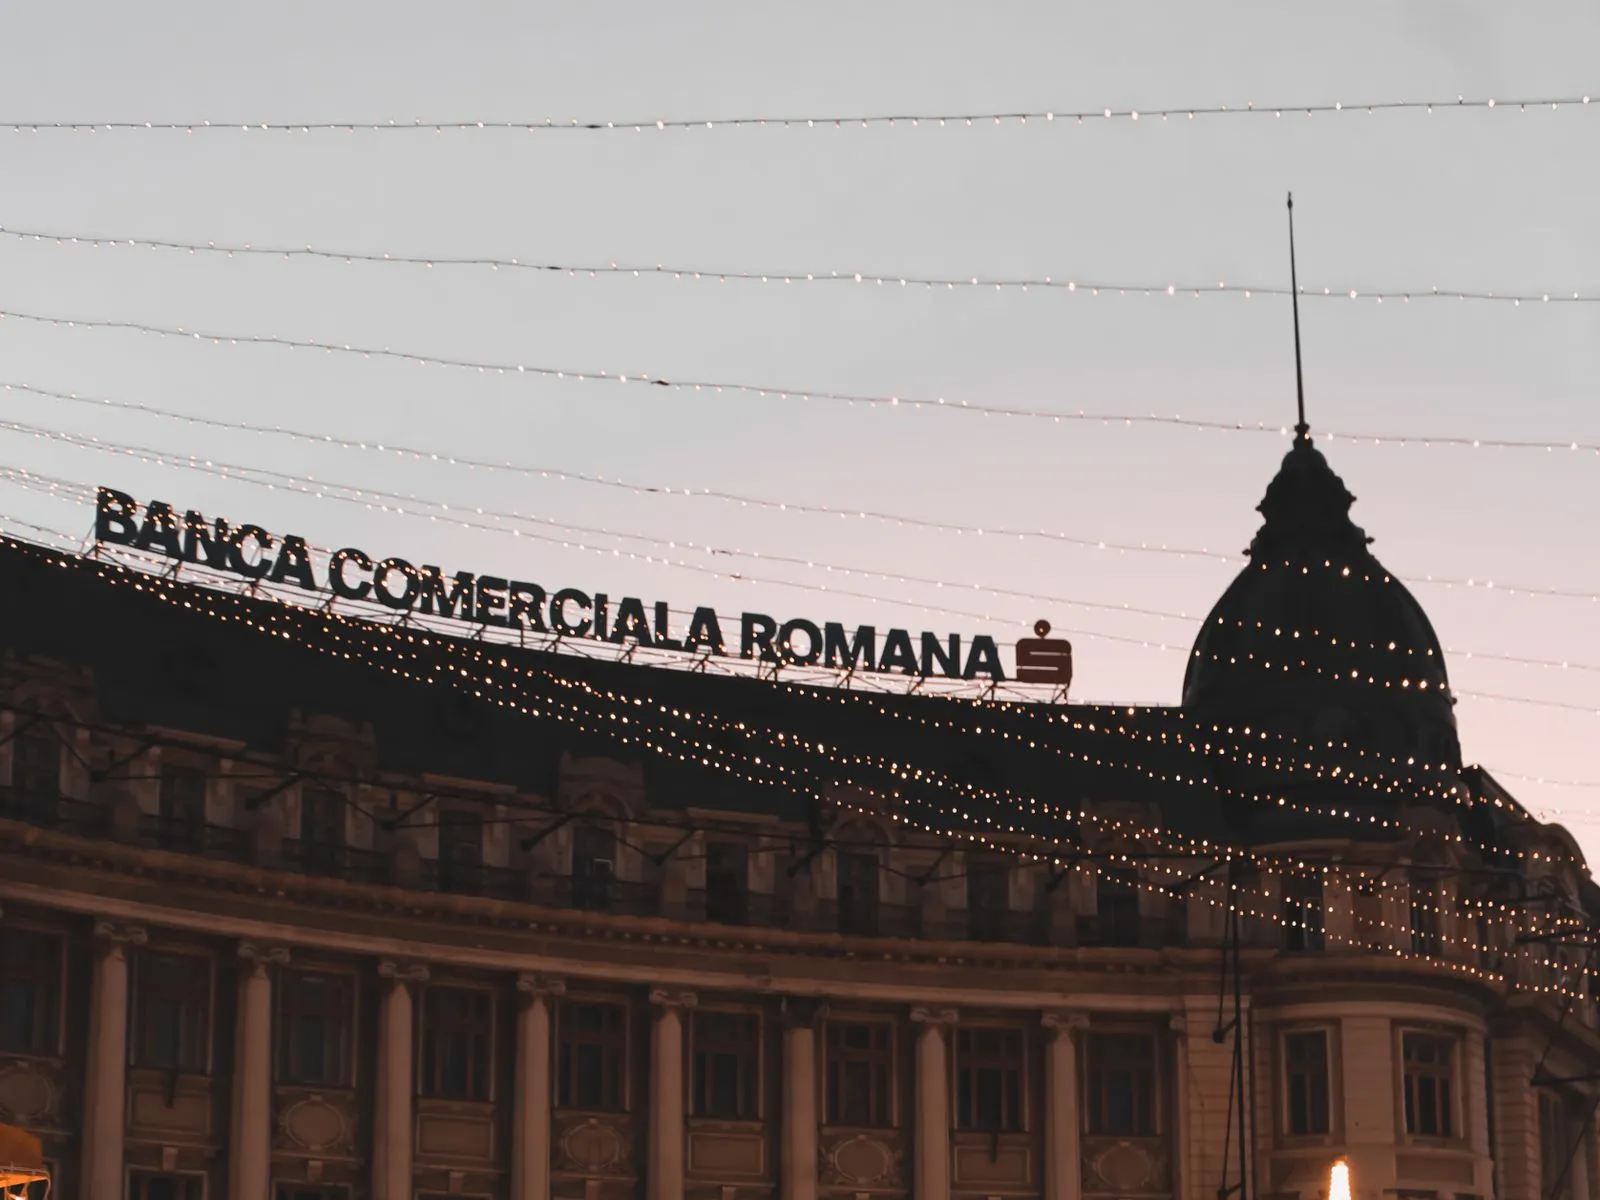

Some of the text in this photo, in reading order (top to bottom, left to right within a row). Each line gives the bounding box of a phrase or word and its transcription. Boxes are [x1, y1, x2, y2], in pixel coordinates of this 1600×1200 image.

[96, 486, 317, 590] BANCA
[329, 547, 727, 656] COMERCIALA
[741, 612, 1005, 681] ROMANA
